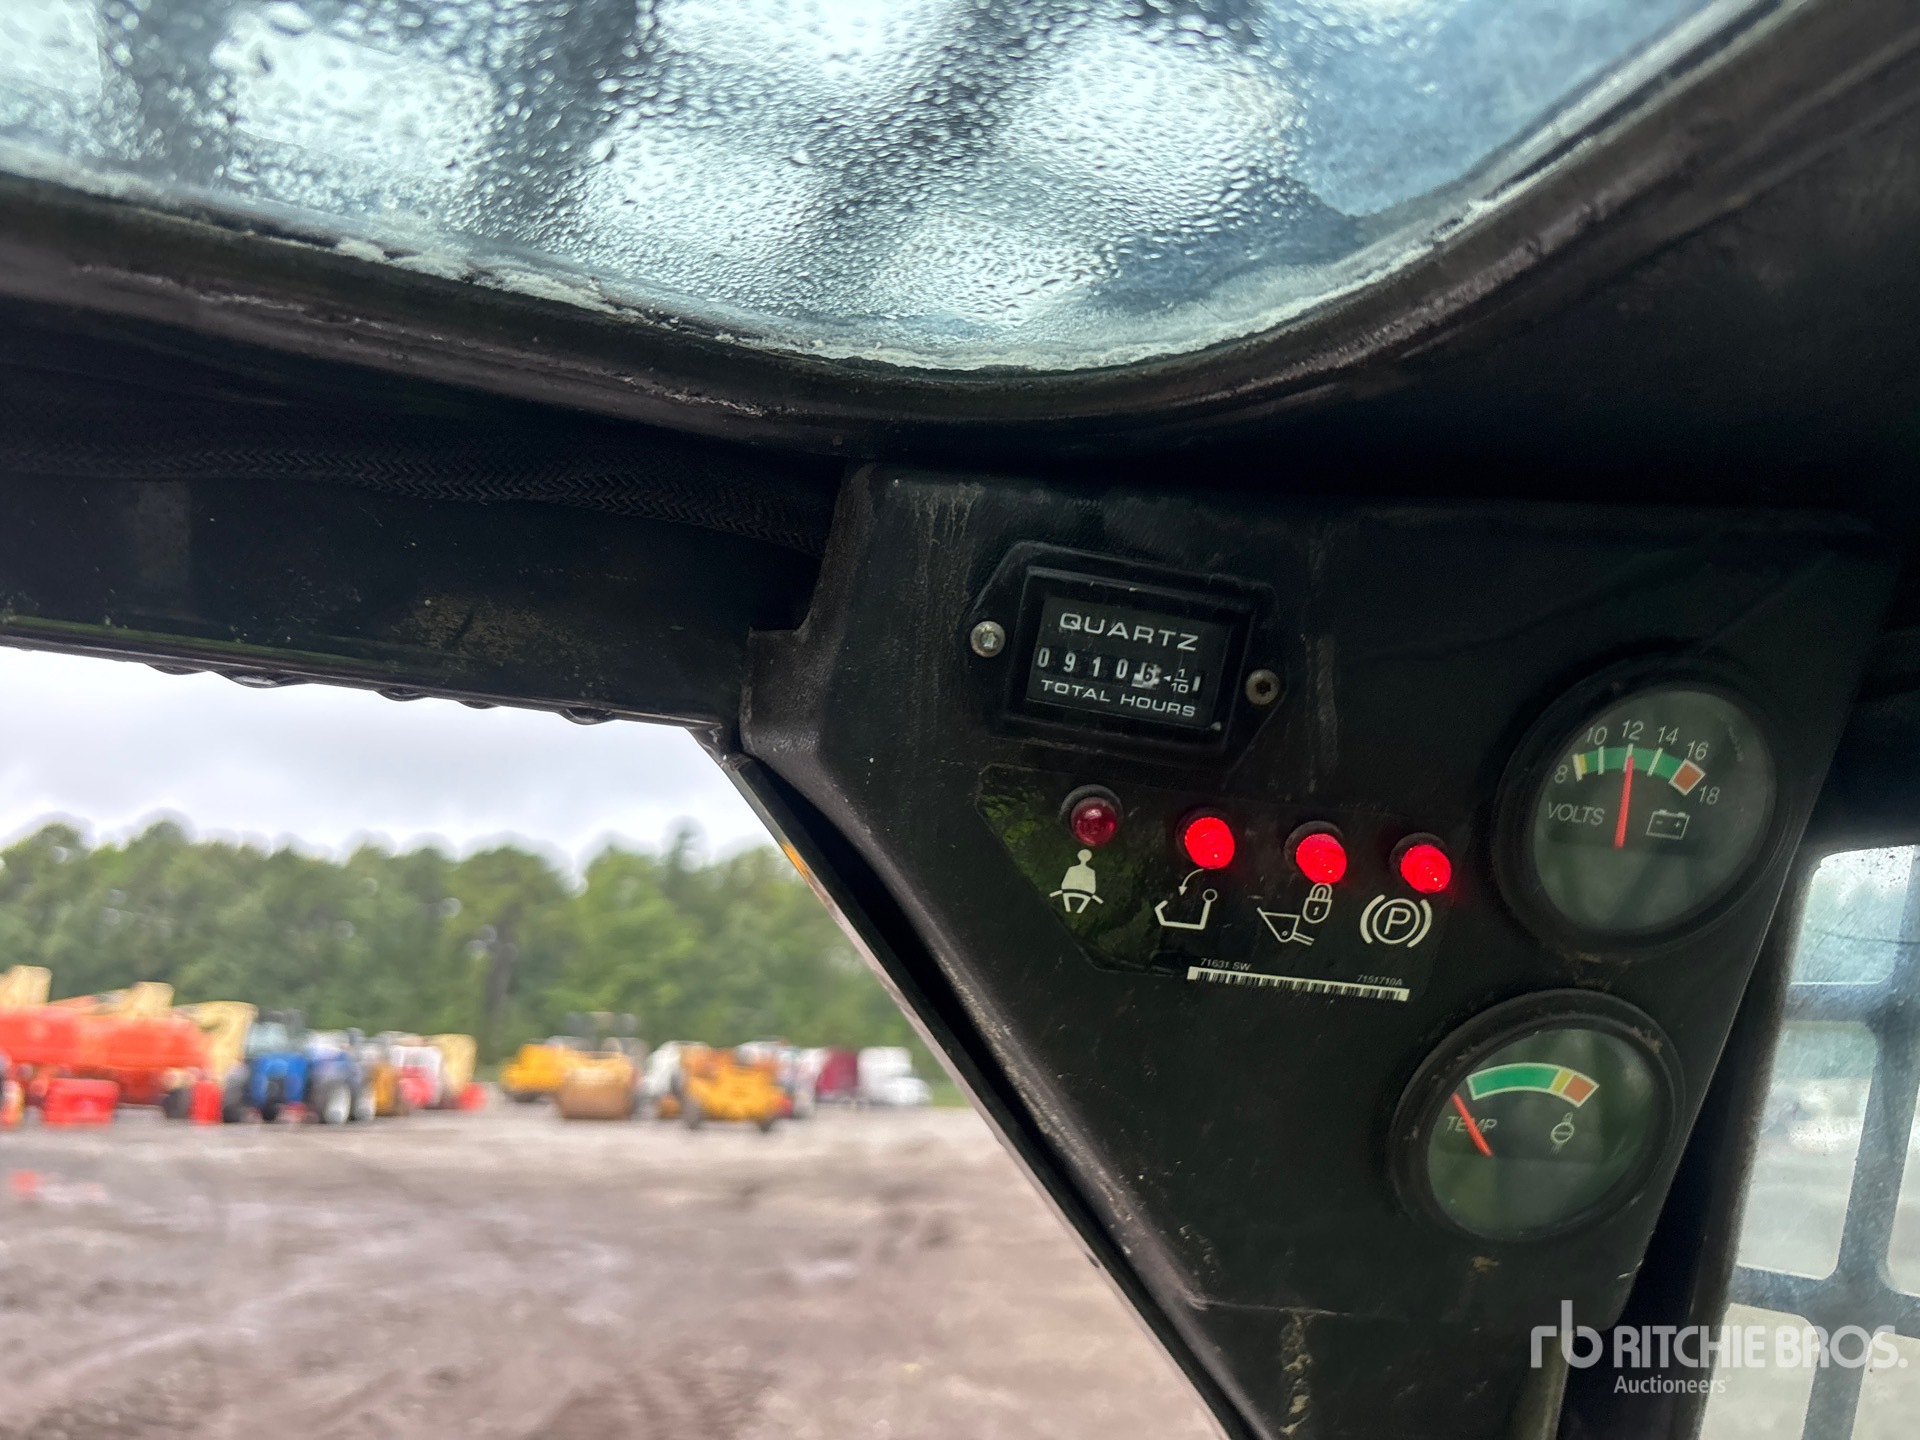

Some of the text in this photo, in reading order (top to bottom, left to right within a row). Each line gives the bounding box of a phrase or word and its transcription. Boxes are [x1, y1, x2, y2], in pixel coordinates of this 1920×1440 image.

[1059, 612, 1199, 651] QUARTZ
[1041, 679, 1197, 718] TOTAL HOURS
[1586, 726, 1608, 745] 10
[1622, 719, 1644, 741] 12
[1657, 725, 1679, 744] 14
[1687, 740, 1709, 760] 16
[1554, 764, 1568, 784] 8
[1699, 784, 1720, 805] 18
[1548, 802, 1605, 826] VOLTS
[1200, 957, 1252, 971] 71631 SW
